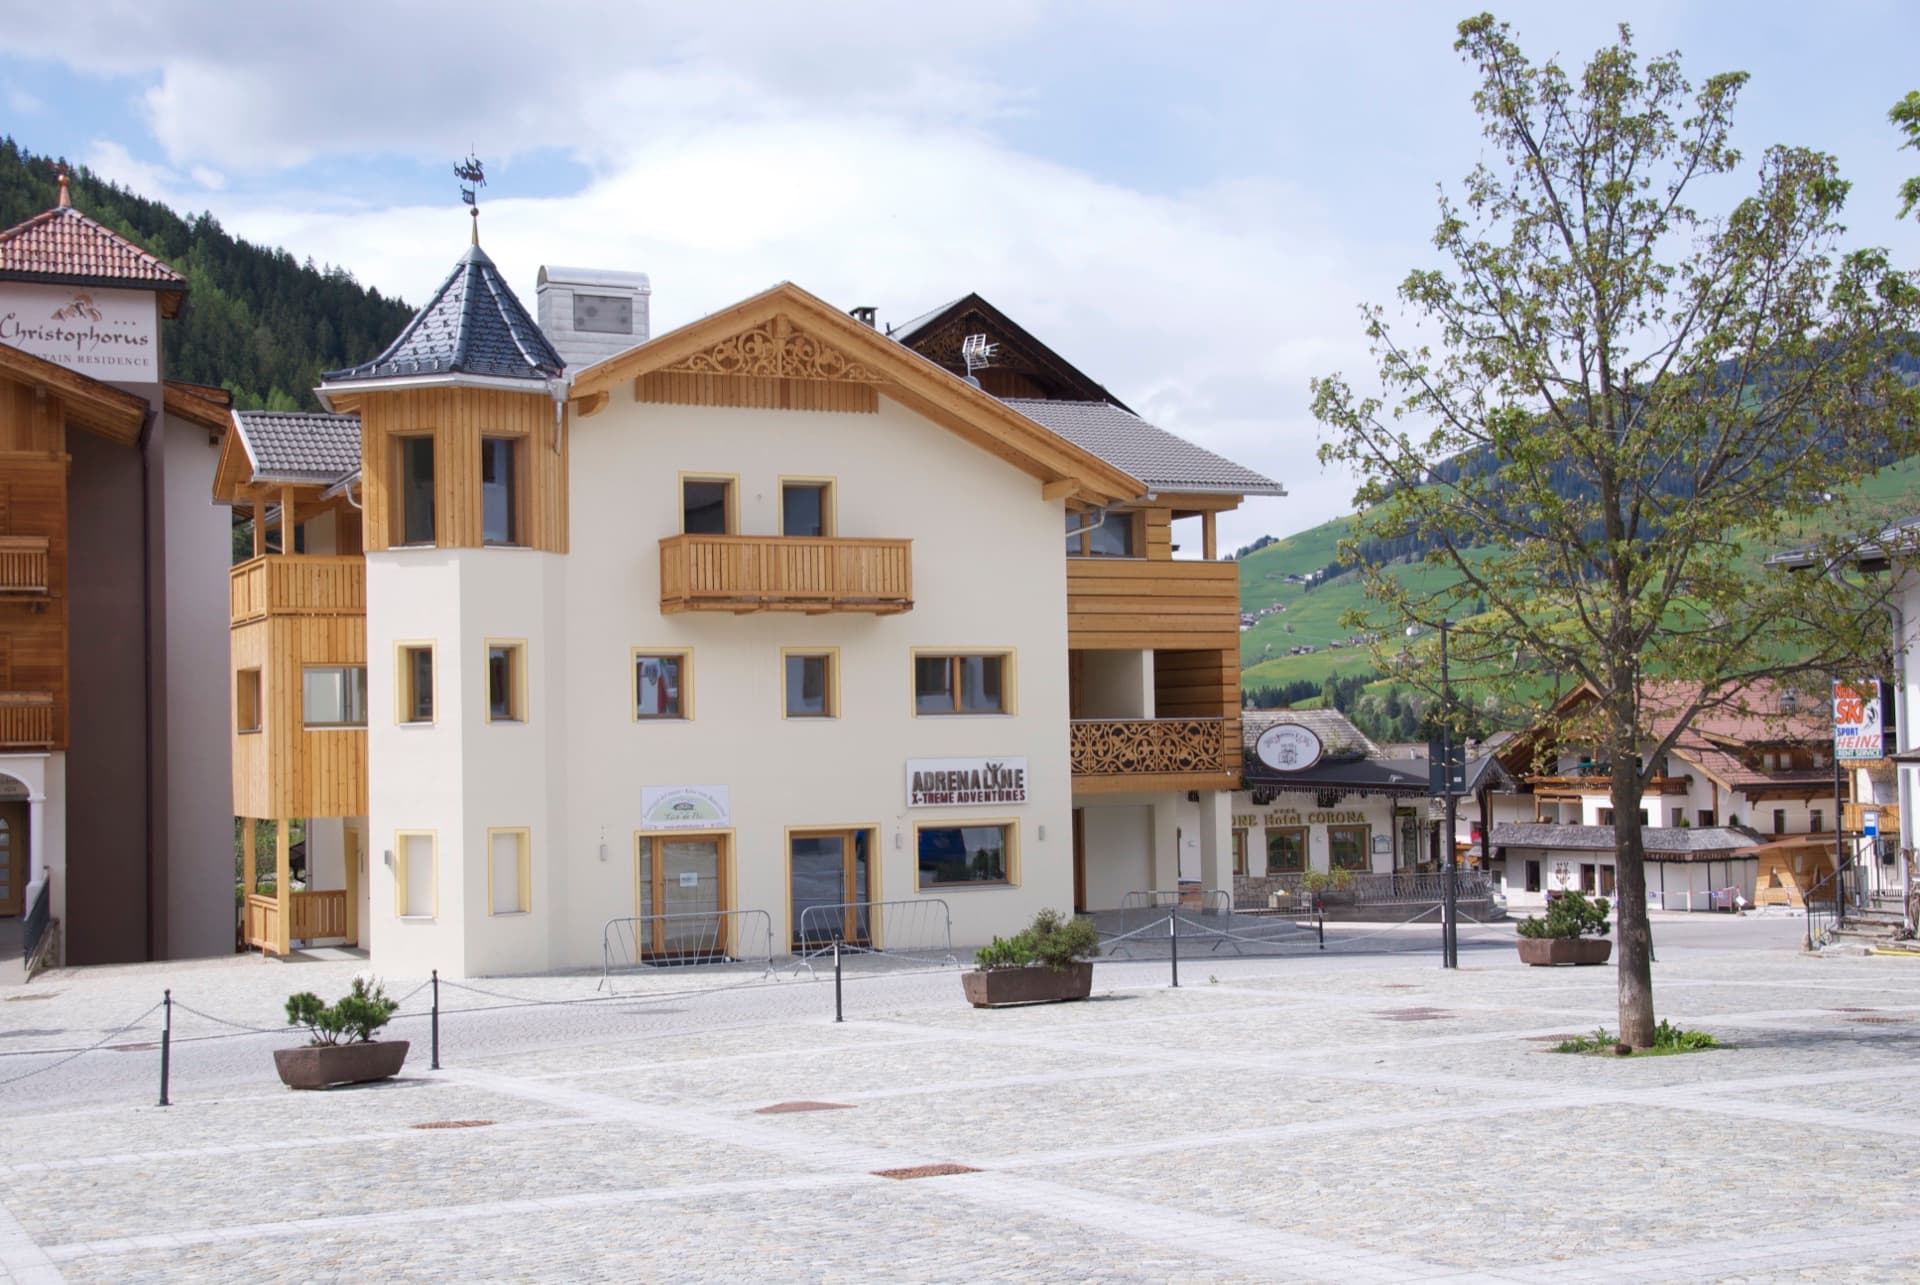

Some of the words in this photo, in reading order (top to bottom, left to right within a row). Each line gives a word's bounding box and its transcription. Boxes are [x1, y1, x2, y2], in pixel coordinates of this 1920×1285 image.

[0, 312, 149, 351] Christophorus
[77, 354, 149, 367] RESIDENCE
[1836, 700, 1863, 724] SKI
[1837, 728, 1858, 736] SPORT
[1838, 735, 1880, 747] HEINZ
[912, 792, 955, 804] X-TREME
[957, 790, 1025, 802] ADVENTURES
[1308, 811, 1366, 824] CORONA
